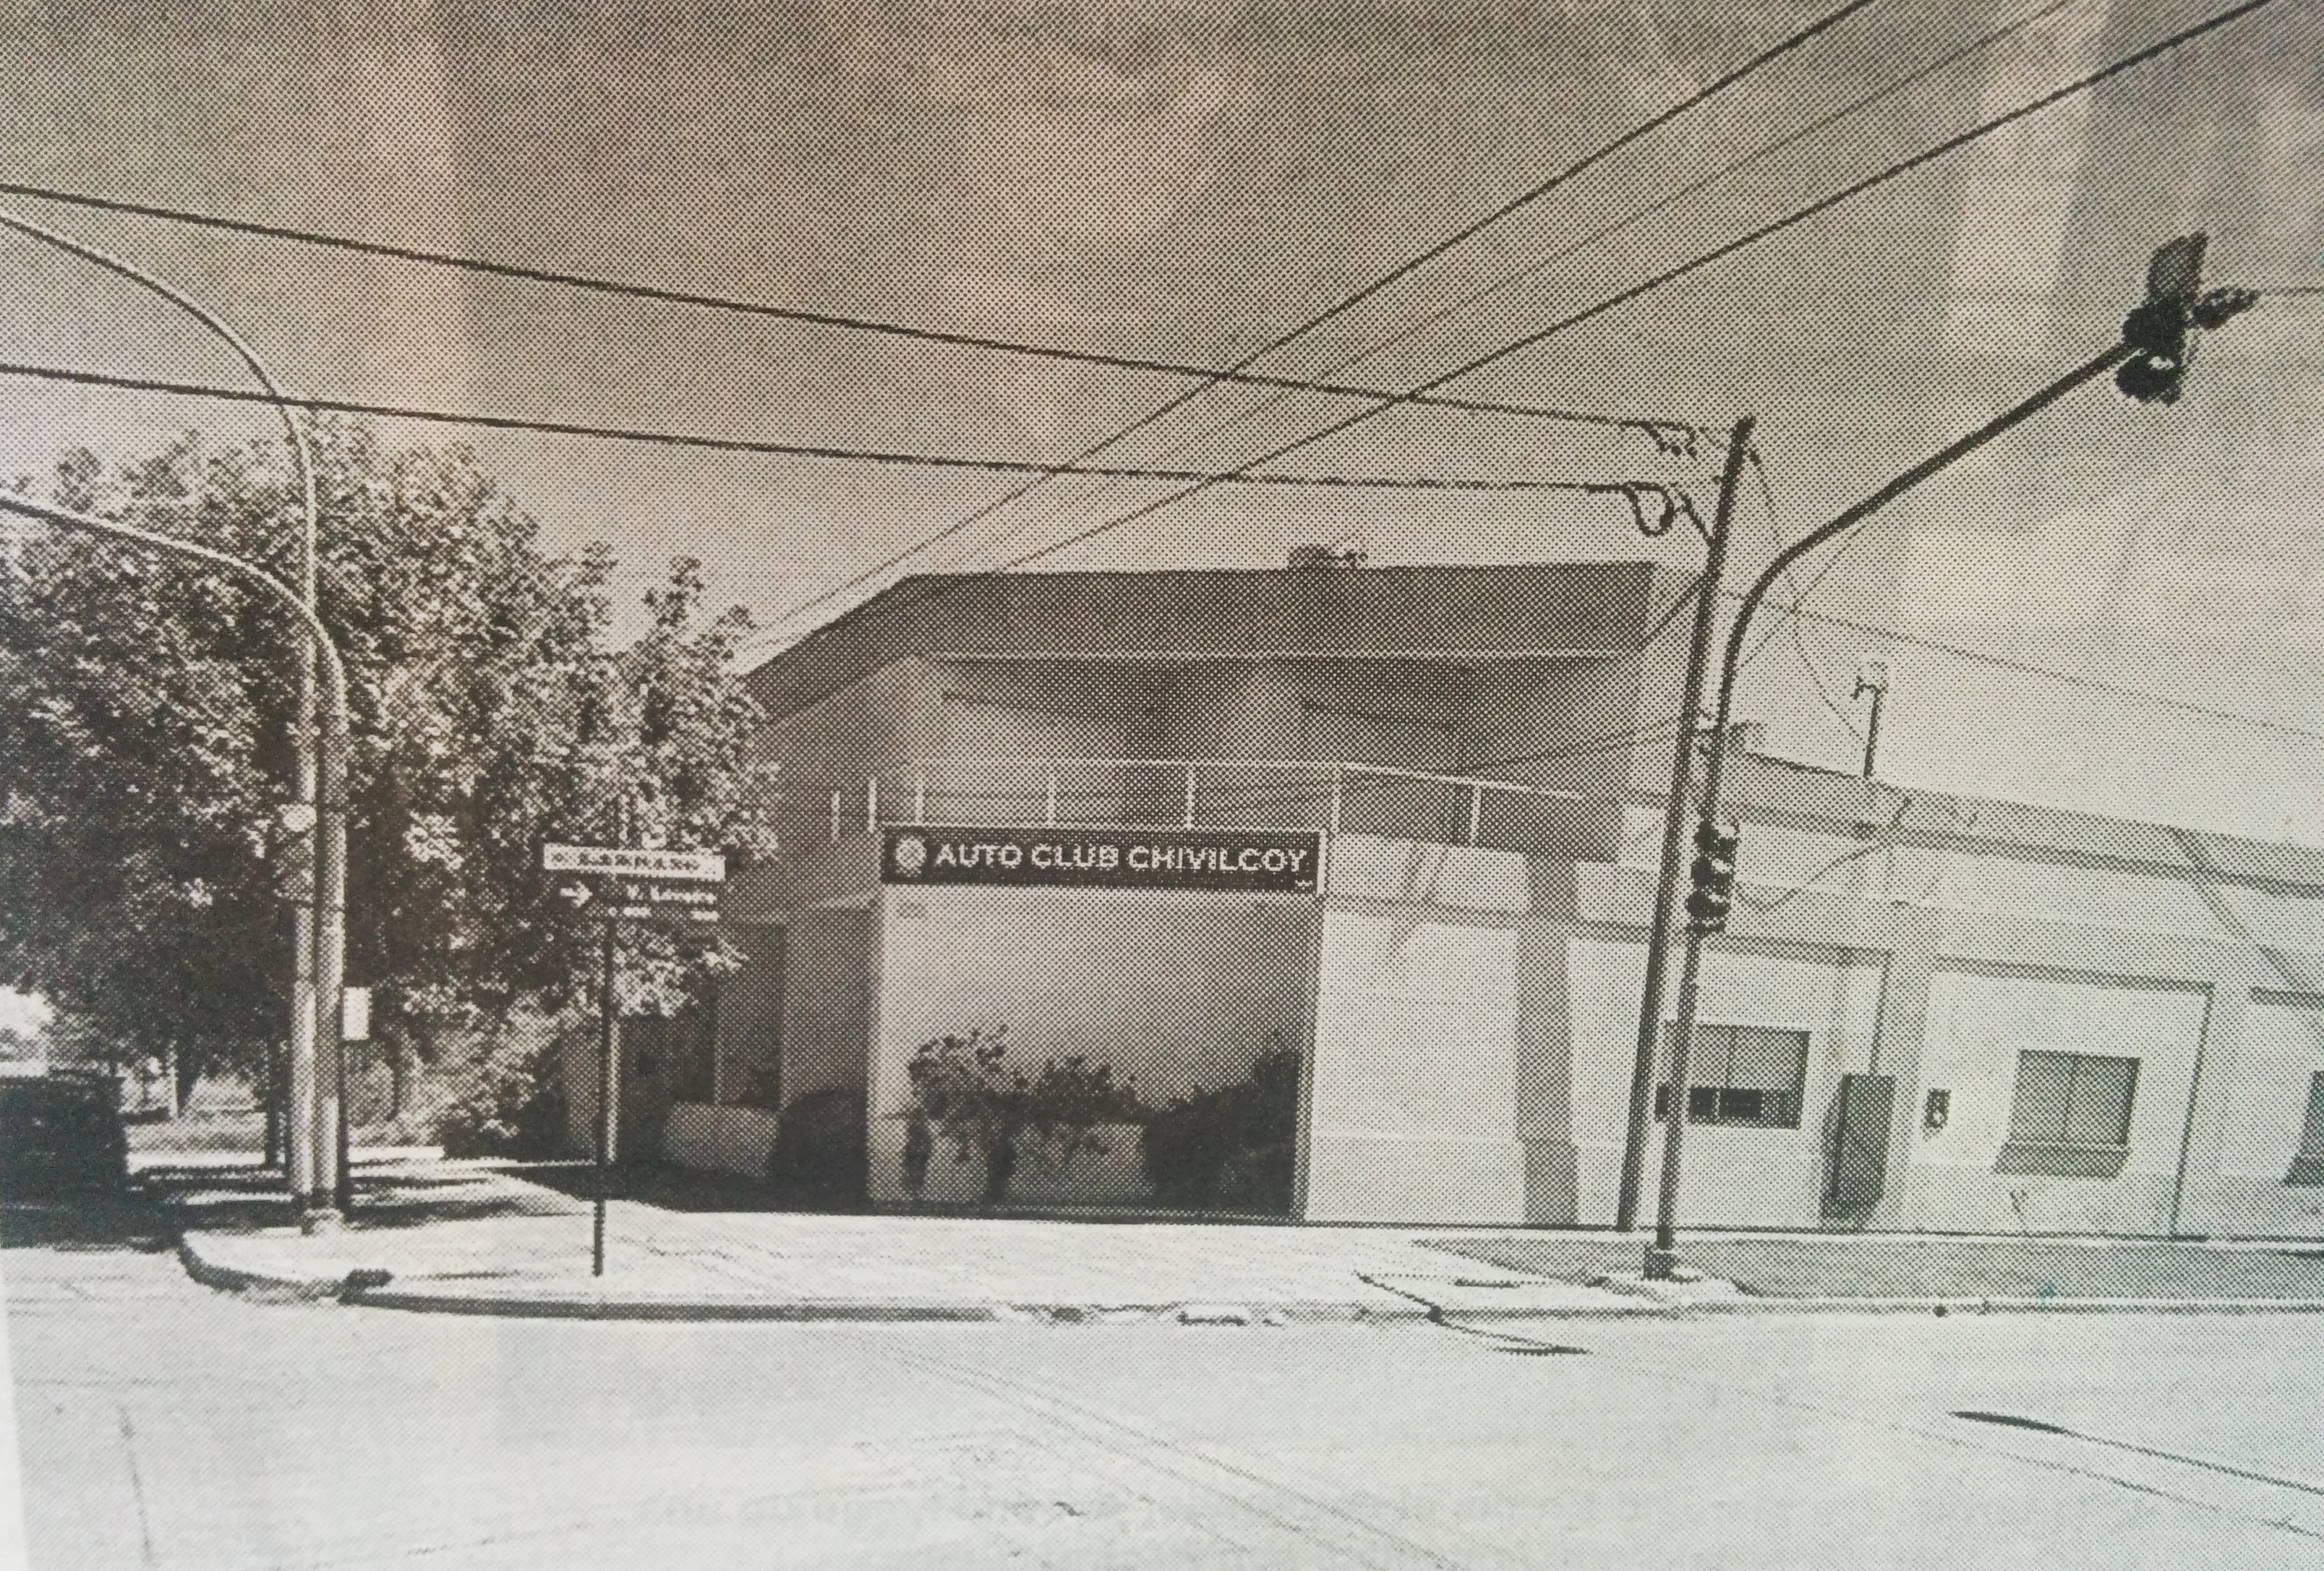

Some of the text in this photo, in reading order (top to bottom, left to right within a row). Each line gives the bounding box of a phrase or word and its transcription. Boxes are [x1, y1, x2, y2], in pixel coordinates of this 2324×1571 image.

[934, 843, 1307, 872] AUTO CLUB CHIVILCOY
